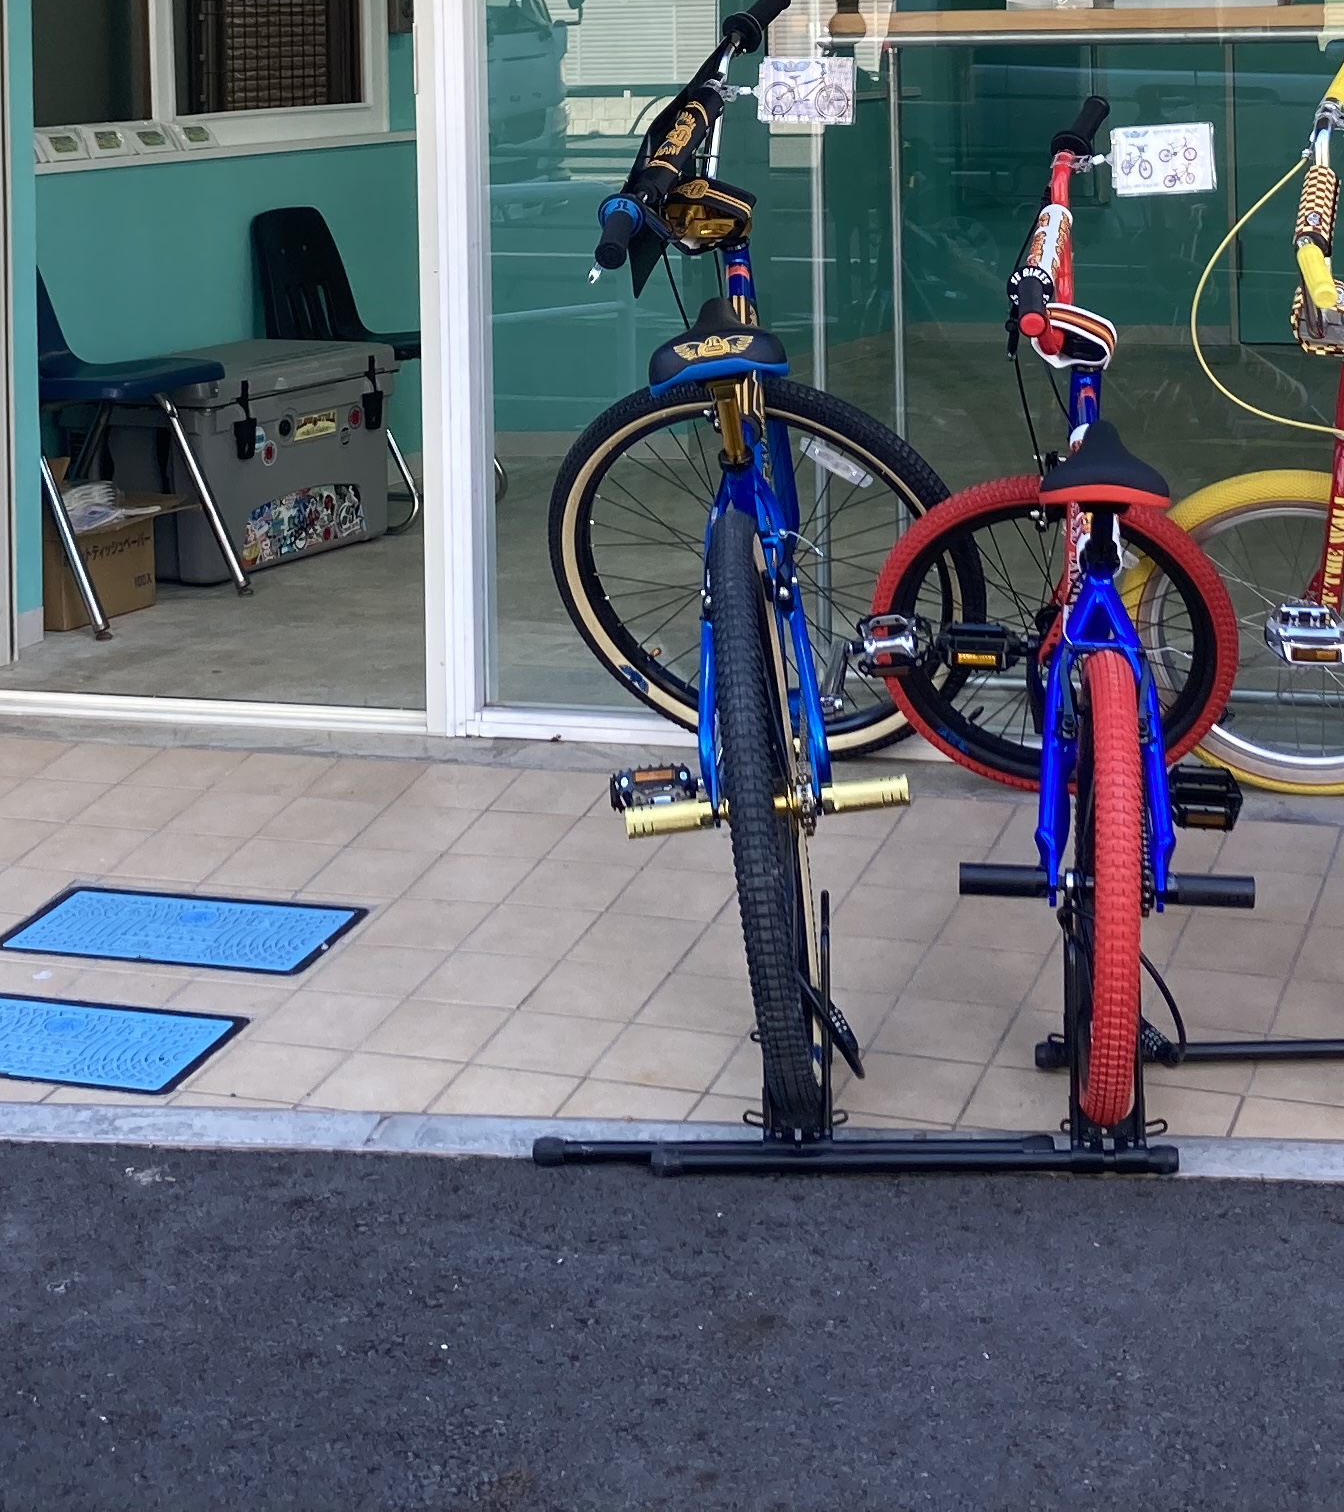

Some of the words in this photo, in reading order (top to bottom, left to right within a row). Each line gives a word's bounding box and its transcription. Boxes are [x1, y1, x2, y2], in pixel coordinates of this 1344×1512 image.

[1022, 267, 1051, 285] BIKES
[64, 533, 152, 567] トティッシュペーパー
[1324, 547, 1344, 587] THE
